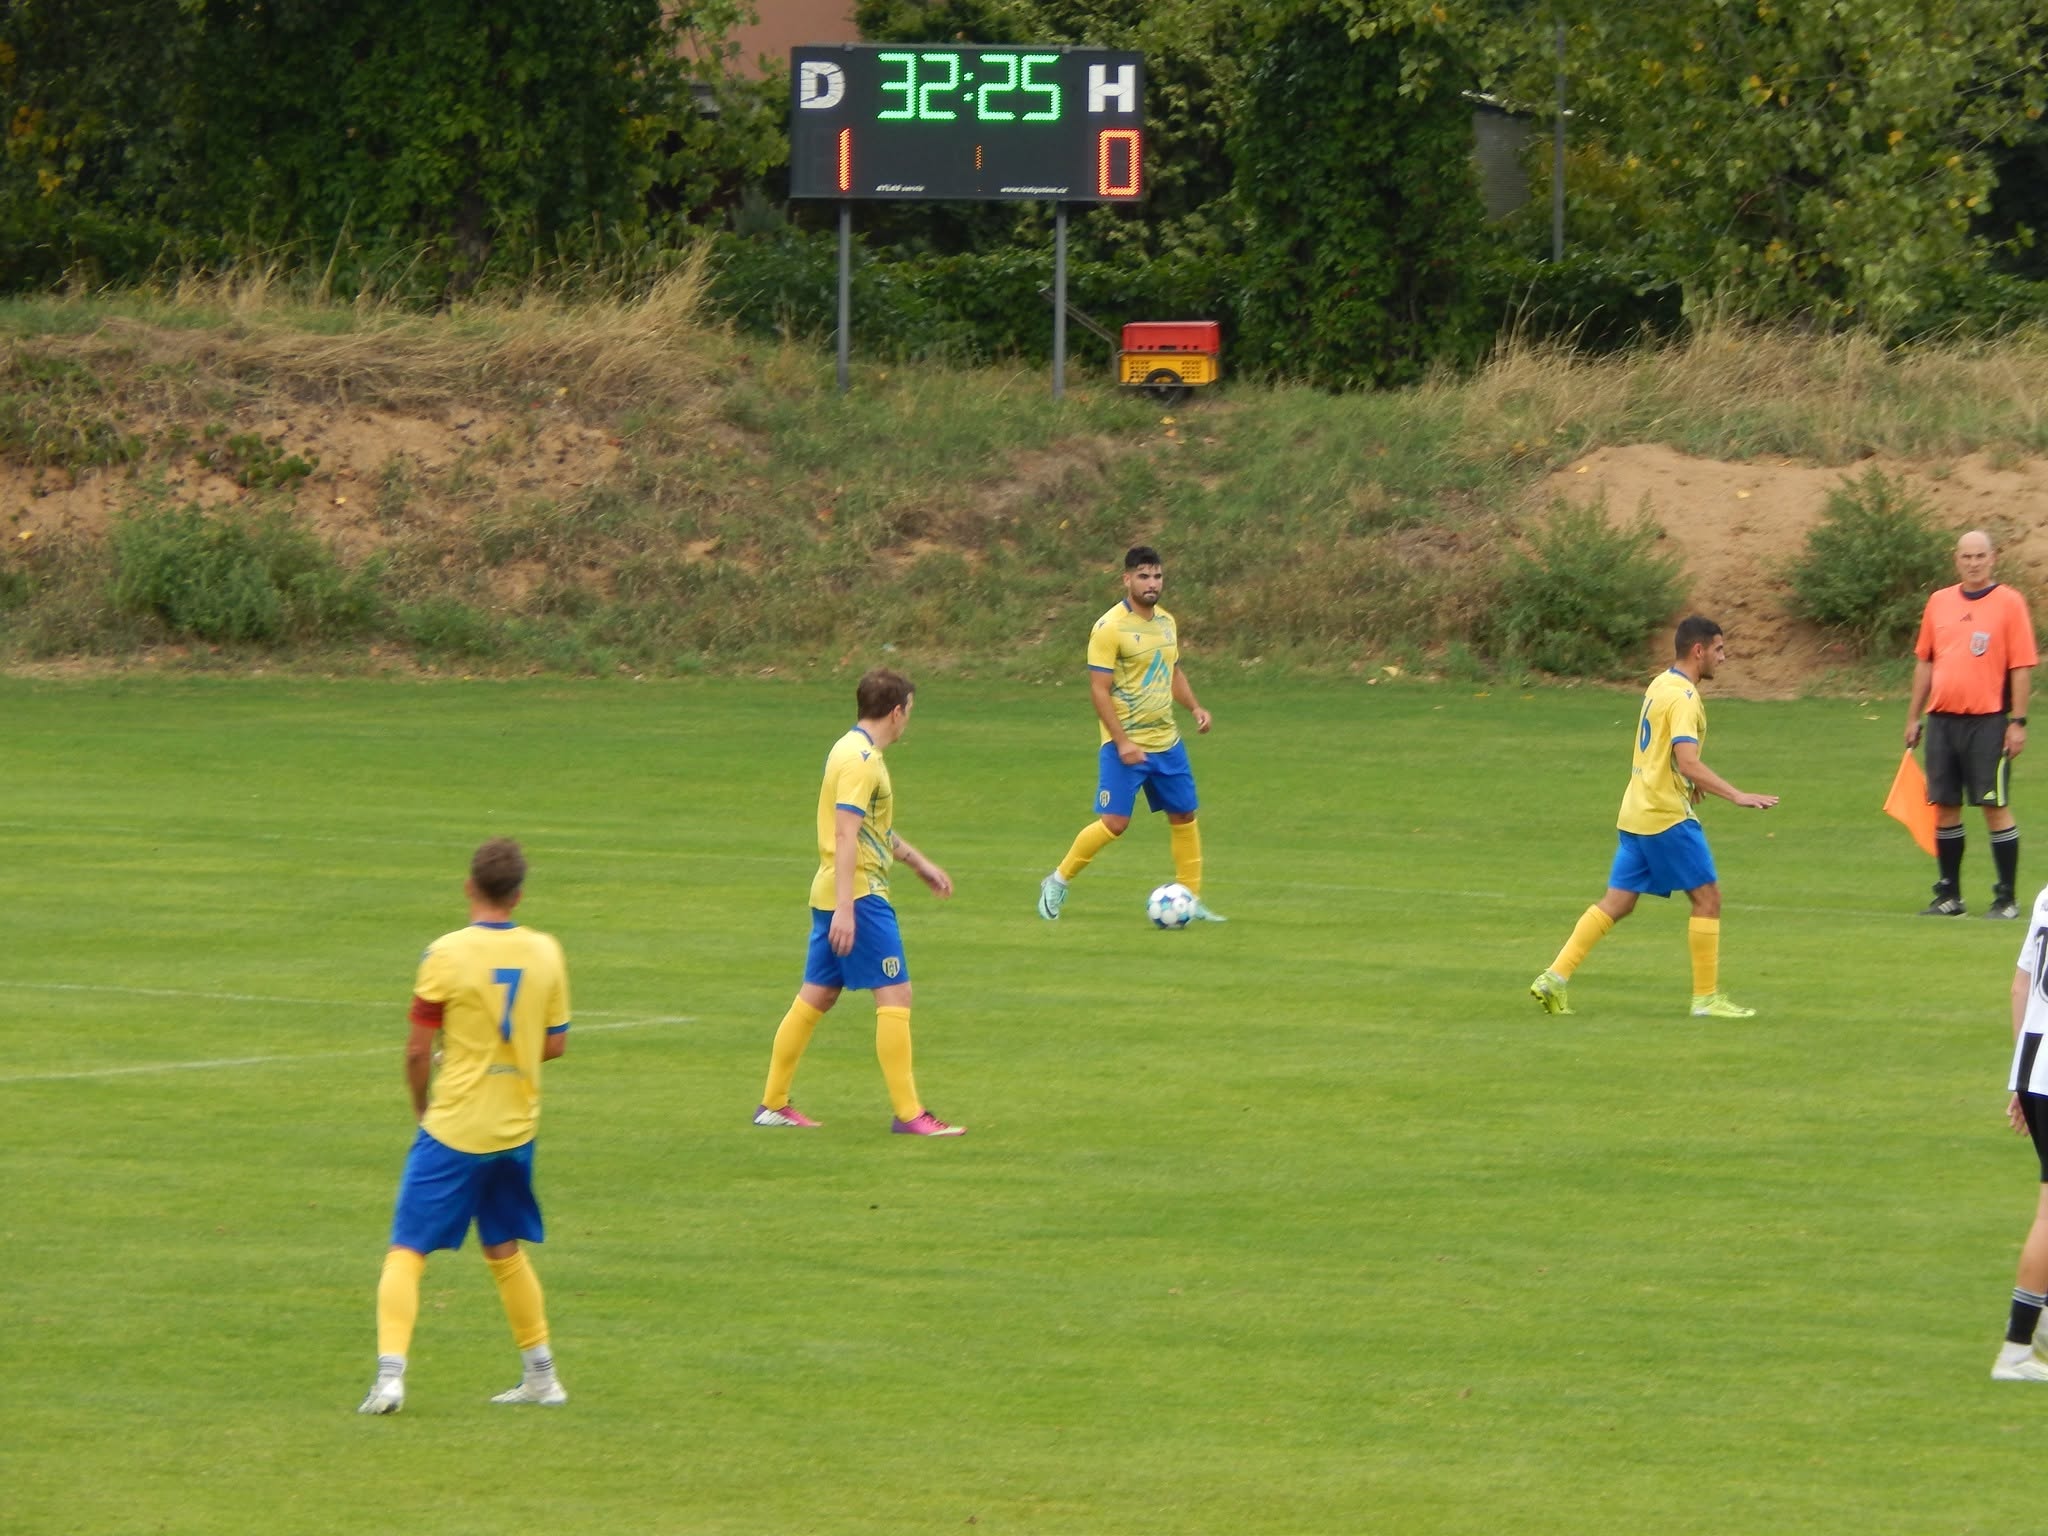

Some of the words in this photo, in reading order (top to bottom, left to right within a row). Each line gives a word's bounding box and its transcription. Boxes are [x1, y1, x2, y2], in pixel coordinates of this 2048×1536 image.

[800, 61, 846, 109] D
[877, 53, 1062, 120] 32:25
[1088, 64, 1136, 113] H
[838, 128, 851, 191] 1
[1098, 128, 1141, 196] 0
[1639, 698, 1653, 753] 6
[2033, 926, 2048, 1002] 1
[491, 968, 524, 1044] 7
